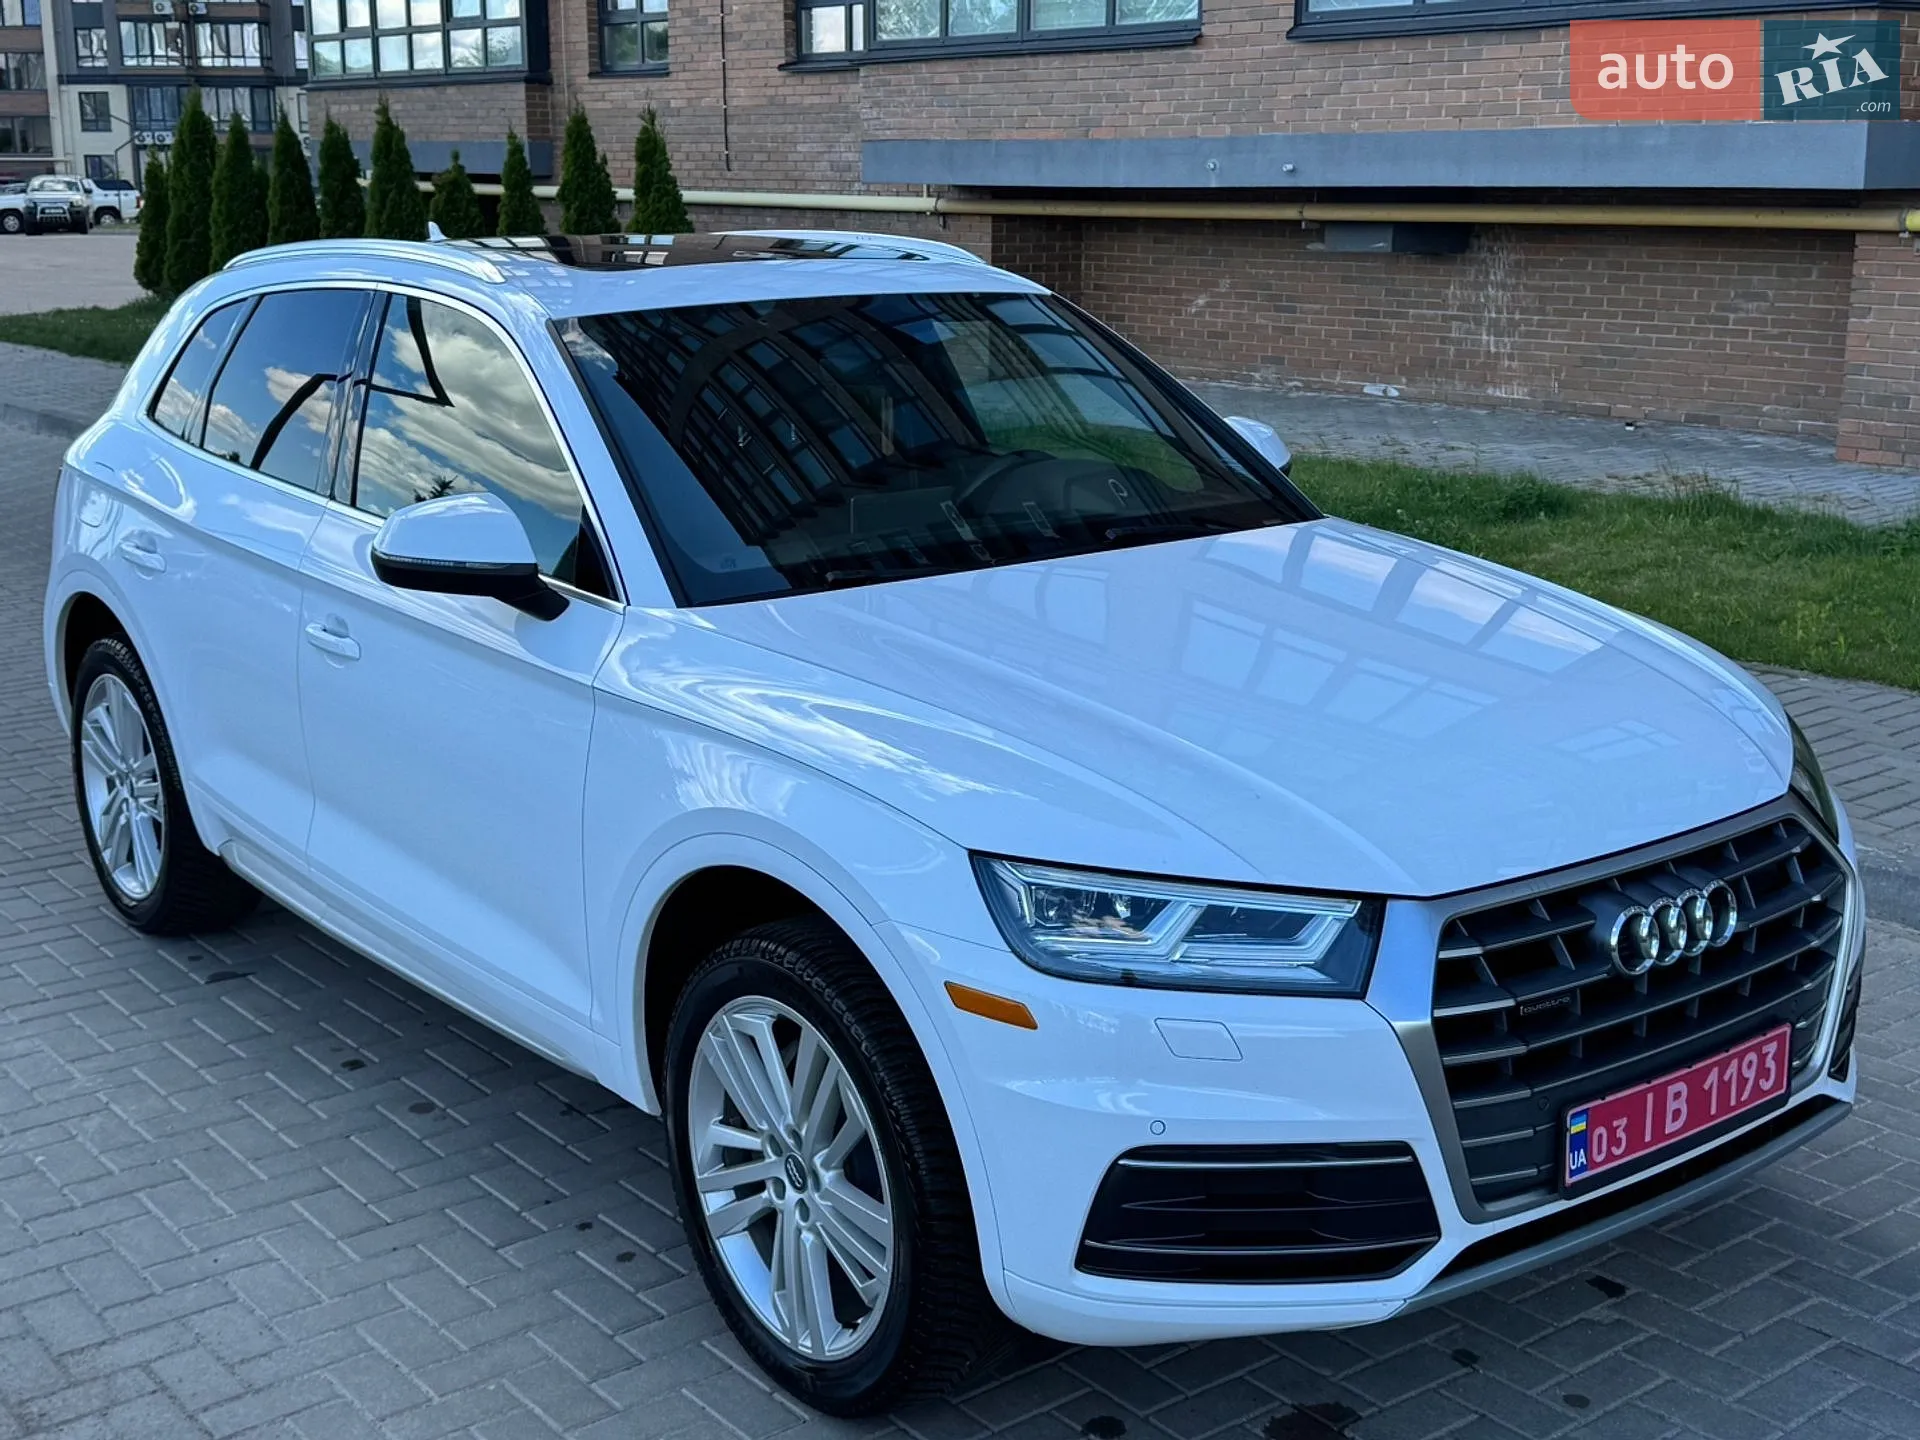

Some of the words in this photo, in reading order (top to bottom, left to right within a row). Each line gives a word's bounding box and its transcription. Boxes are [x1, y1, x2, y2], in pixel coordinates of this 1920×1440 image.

[1592, 1117, 1628, 1163] 03
[1644, 1081, 1688, 1142] IB
[1703, 1041, 1778, 1116] 1193
[1569, 1149, 1587, 1171] UA
